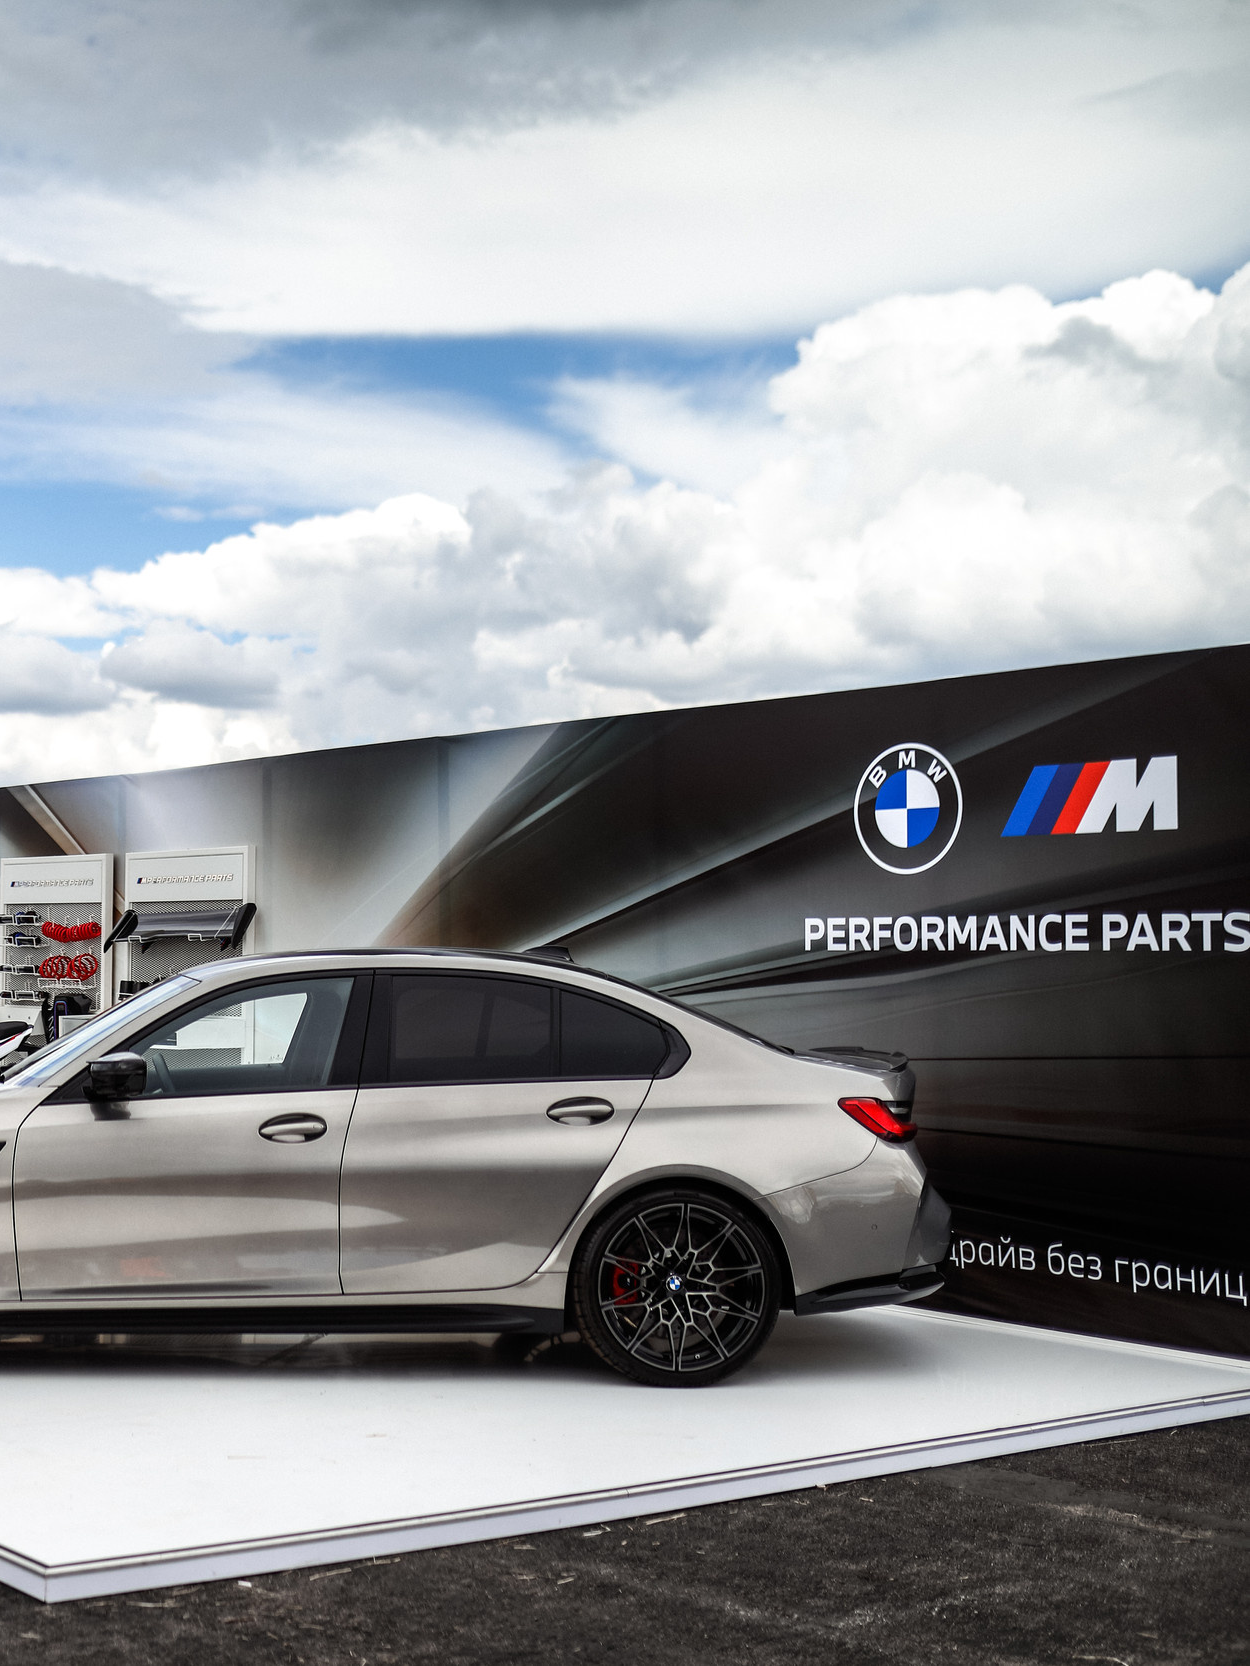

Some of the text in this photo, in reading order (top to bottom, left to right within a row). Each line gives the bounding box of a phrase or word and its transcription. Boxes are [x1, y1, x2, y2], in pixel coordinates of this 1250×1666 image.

[868, 750, 948, 789] BMW
[1075, 755, 1179, 835] M
[205, 873, 234, 883] PARTS
[803, 911, 1250, 953] PERFORMANCE PARTS
[1047, 1241, 1103, 1281] без
[1114, 1258, 1248, 1307] границ
